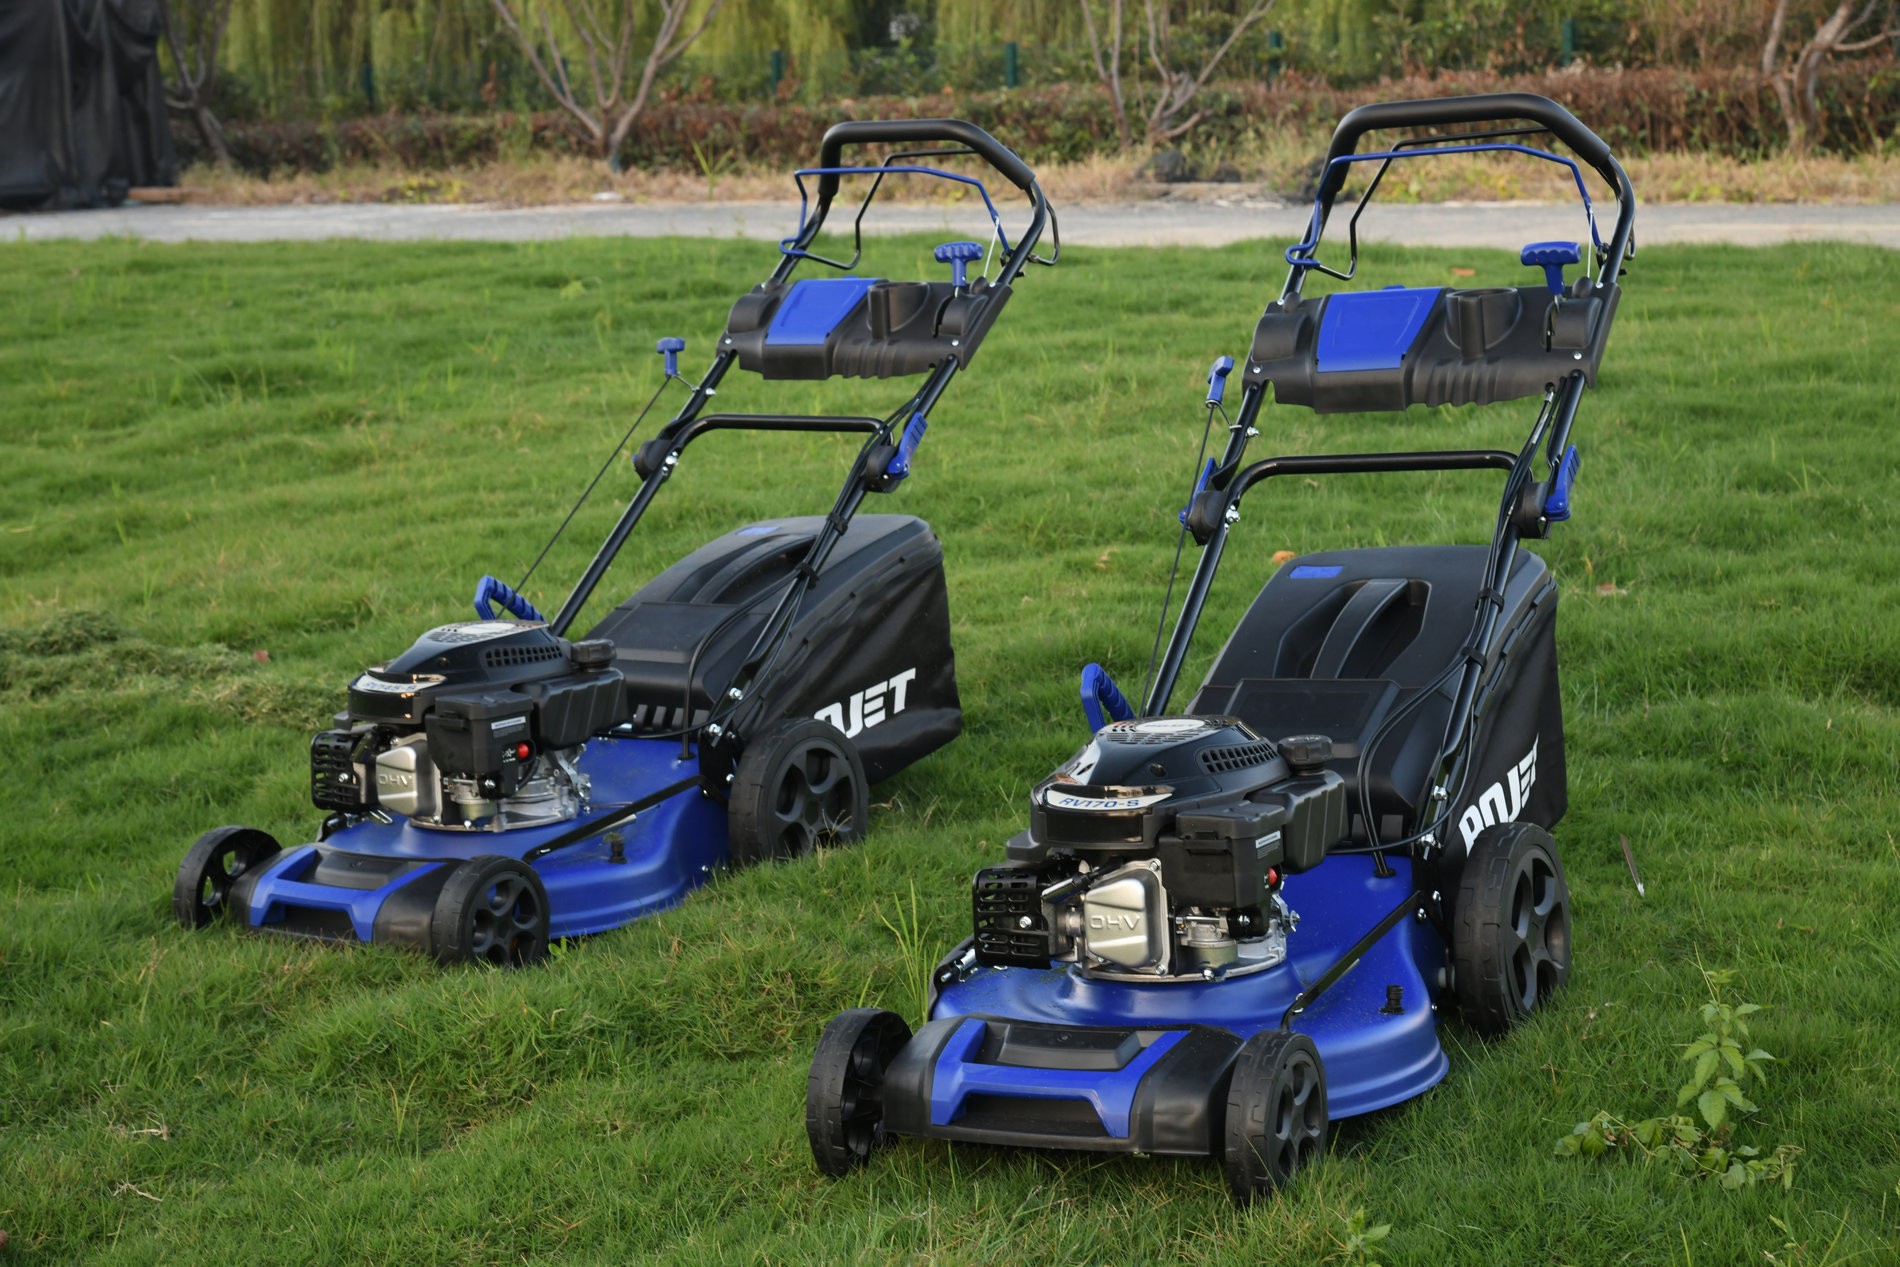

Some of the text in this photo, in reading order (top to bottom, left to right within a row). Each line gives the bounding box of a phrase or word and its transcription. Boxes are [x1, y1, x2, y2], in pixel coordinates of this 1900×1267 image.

[378, 773, 413, 787] OHV
[1058, 797, 1140, 808] RV170-S
[1090, 914, 1141, 930] OHV
